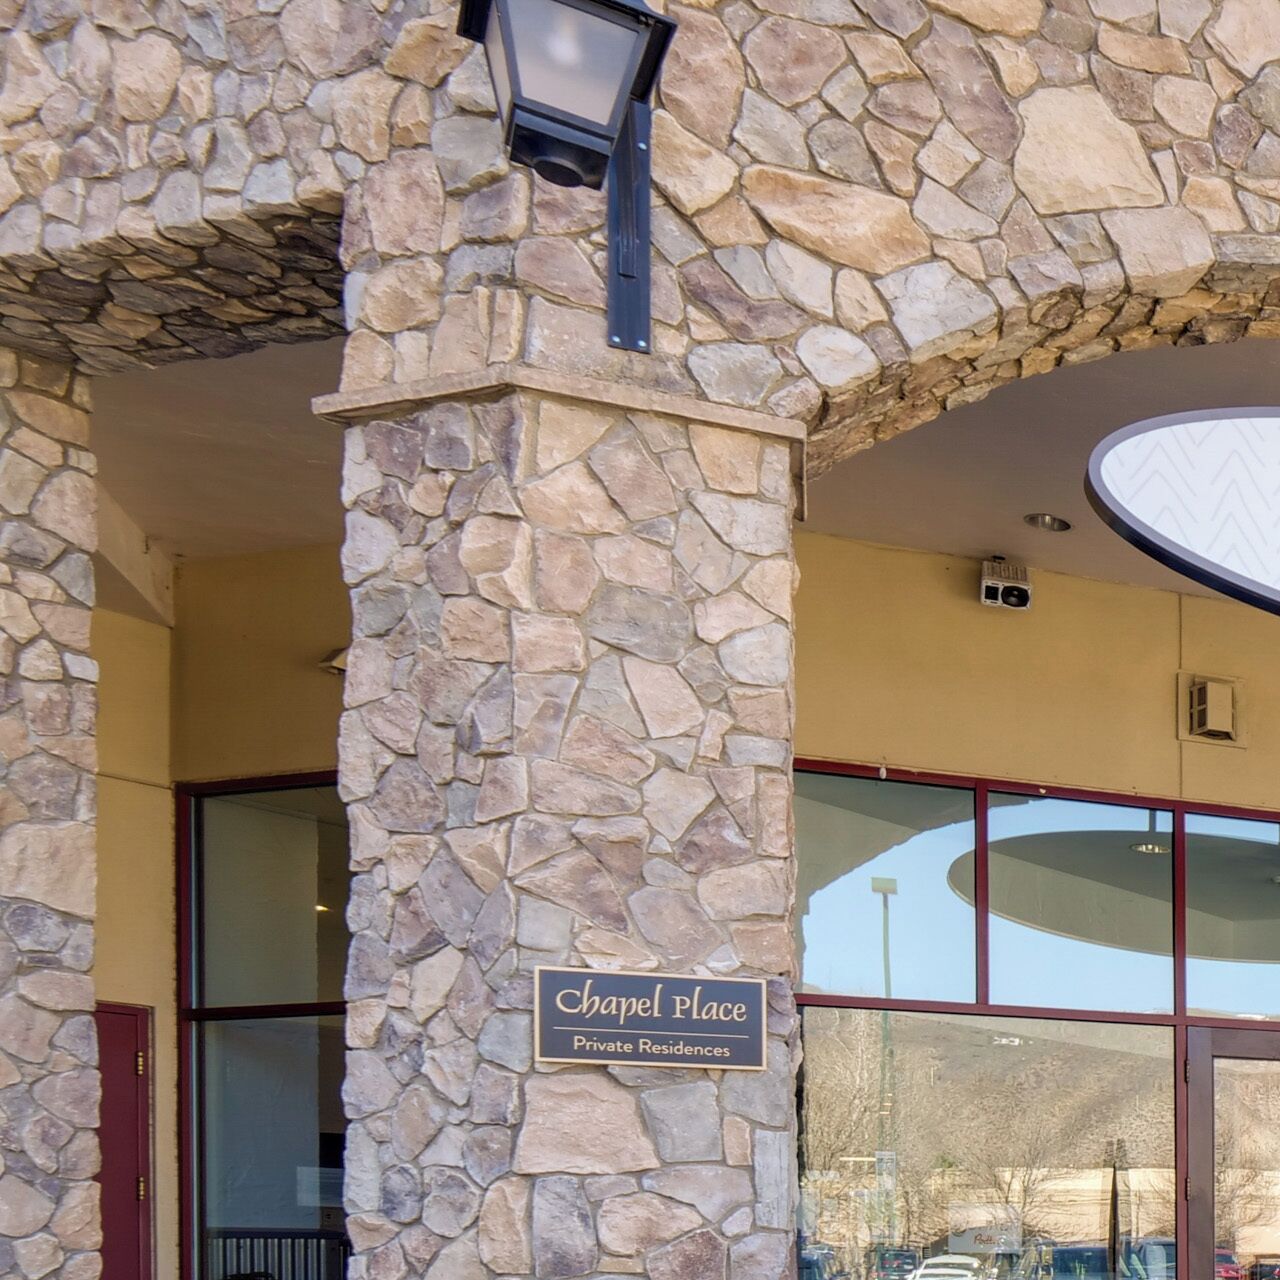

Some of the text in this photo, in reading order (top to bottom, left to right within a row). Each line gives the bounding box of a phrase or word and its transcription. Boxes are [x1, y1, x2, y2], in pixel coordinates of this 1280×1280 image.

[556, 979, 747, 1025] Chapel Place
[573, 1036, 731, 1057] Private Residences
